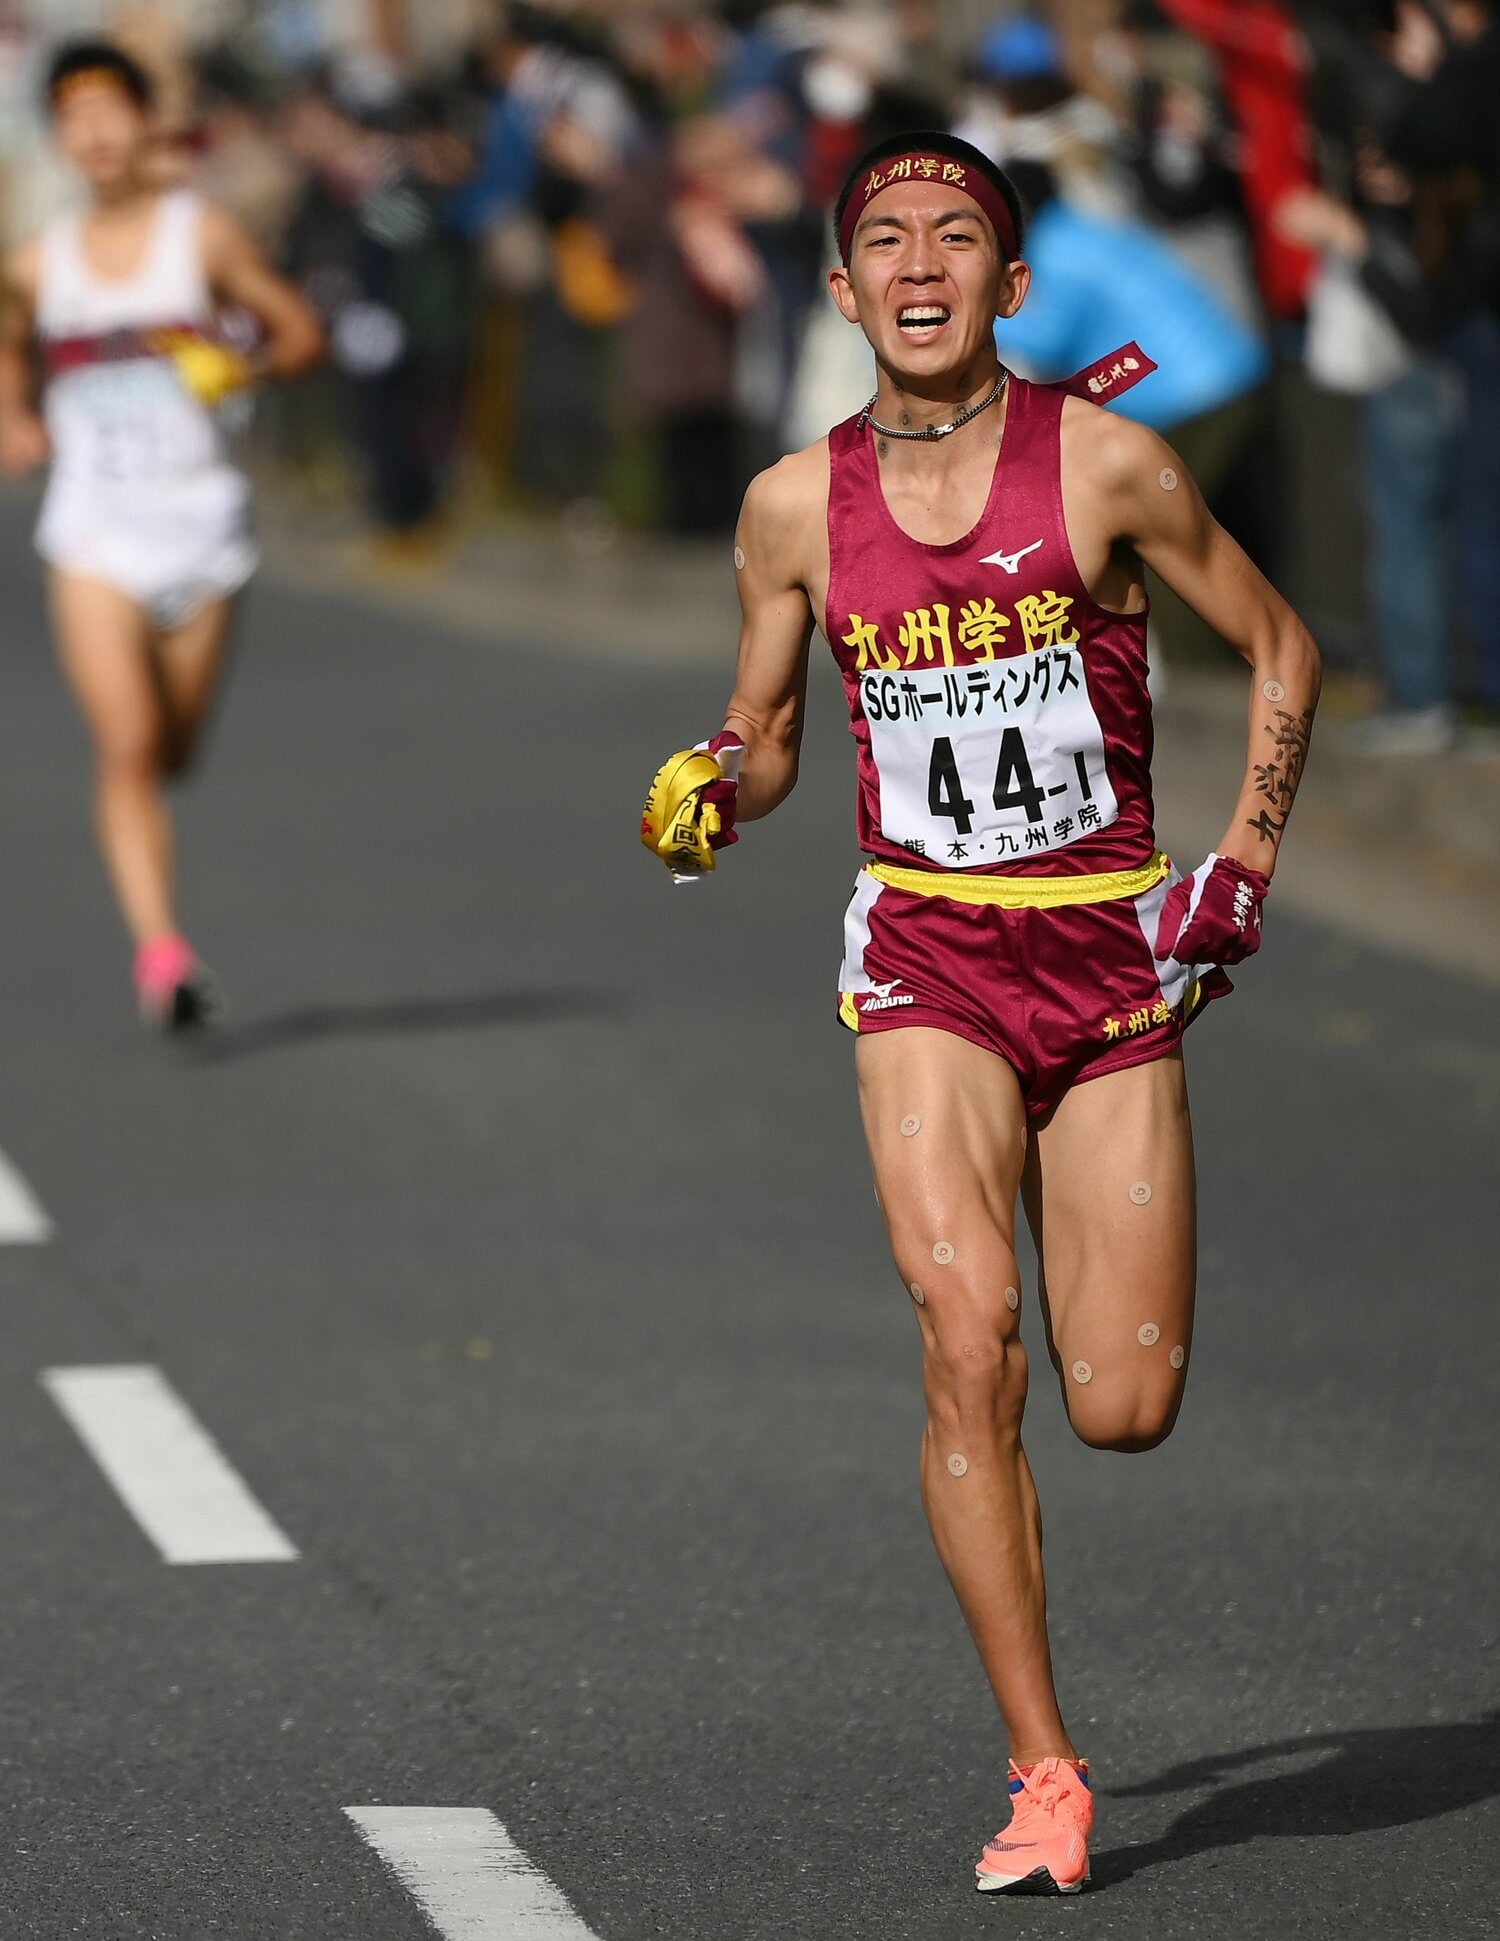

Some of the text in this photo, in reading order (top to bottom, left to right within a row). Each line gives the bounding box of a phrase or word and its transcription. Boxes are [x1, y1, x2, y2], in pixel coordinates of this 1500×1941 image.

[865, 158, 966, 200] 九州学院
[842, 591, 1080, 671] 九州学院
[864, 652, 1080, 722] SGホールディングス
[1102, 1000, 1175, 1041] 九州学
